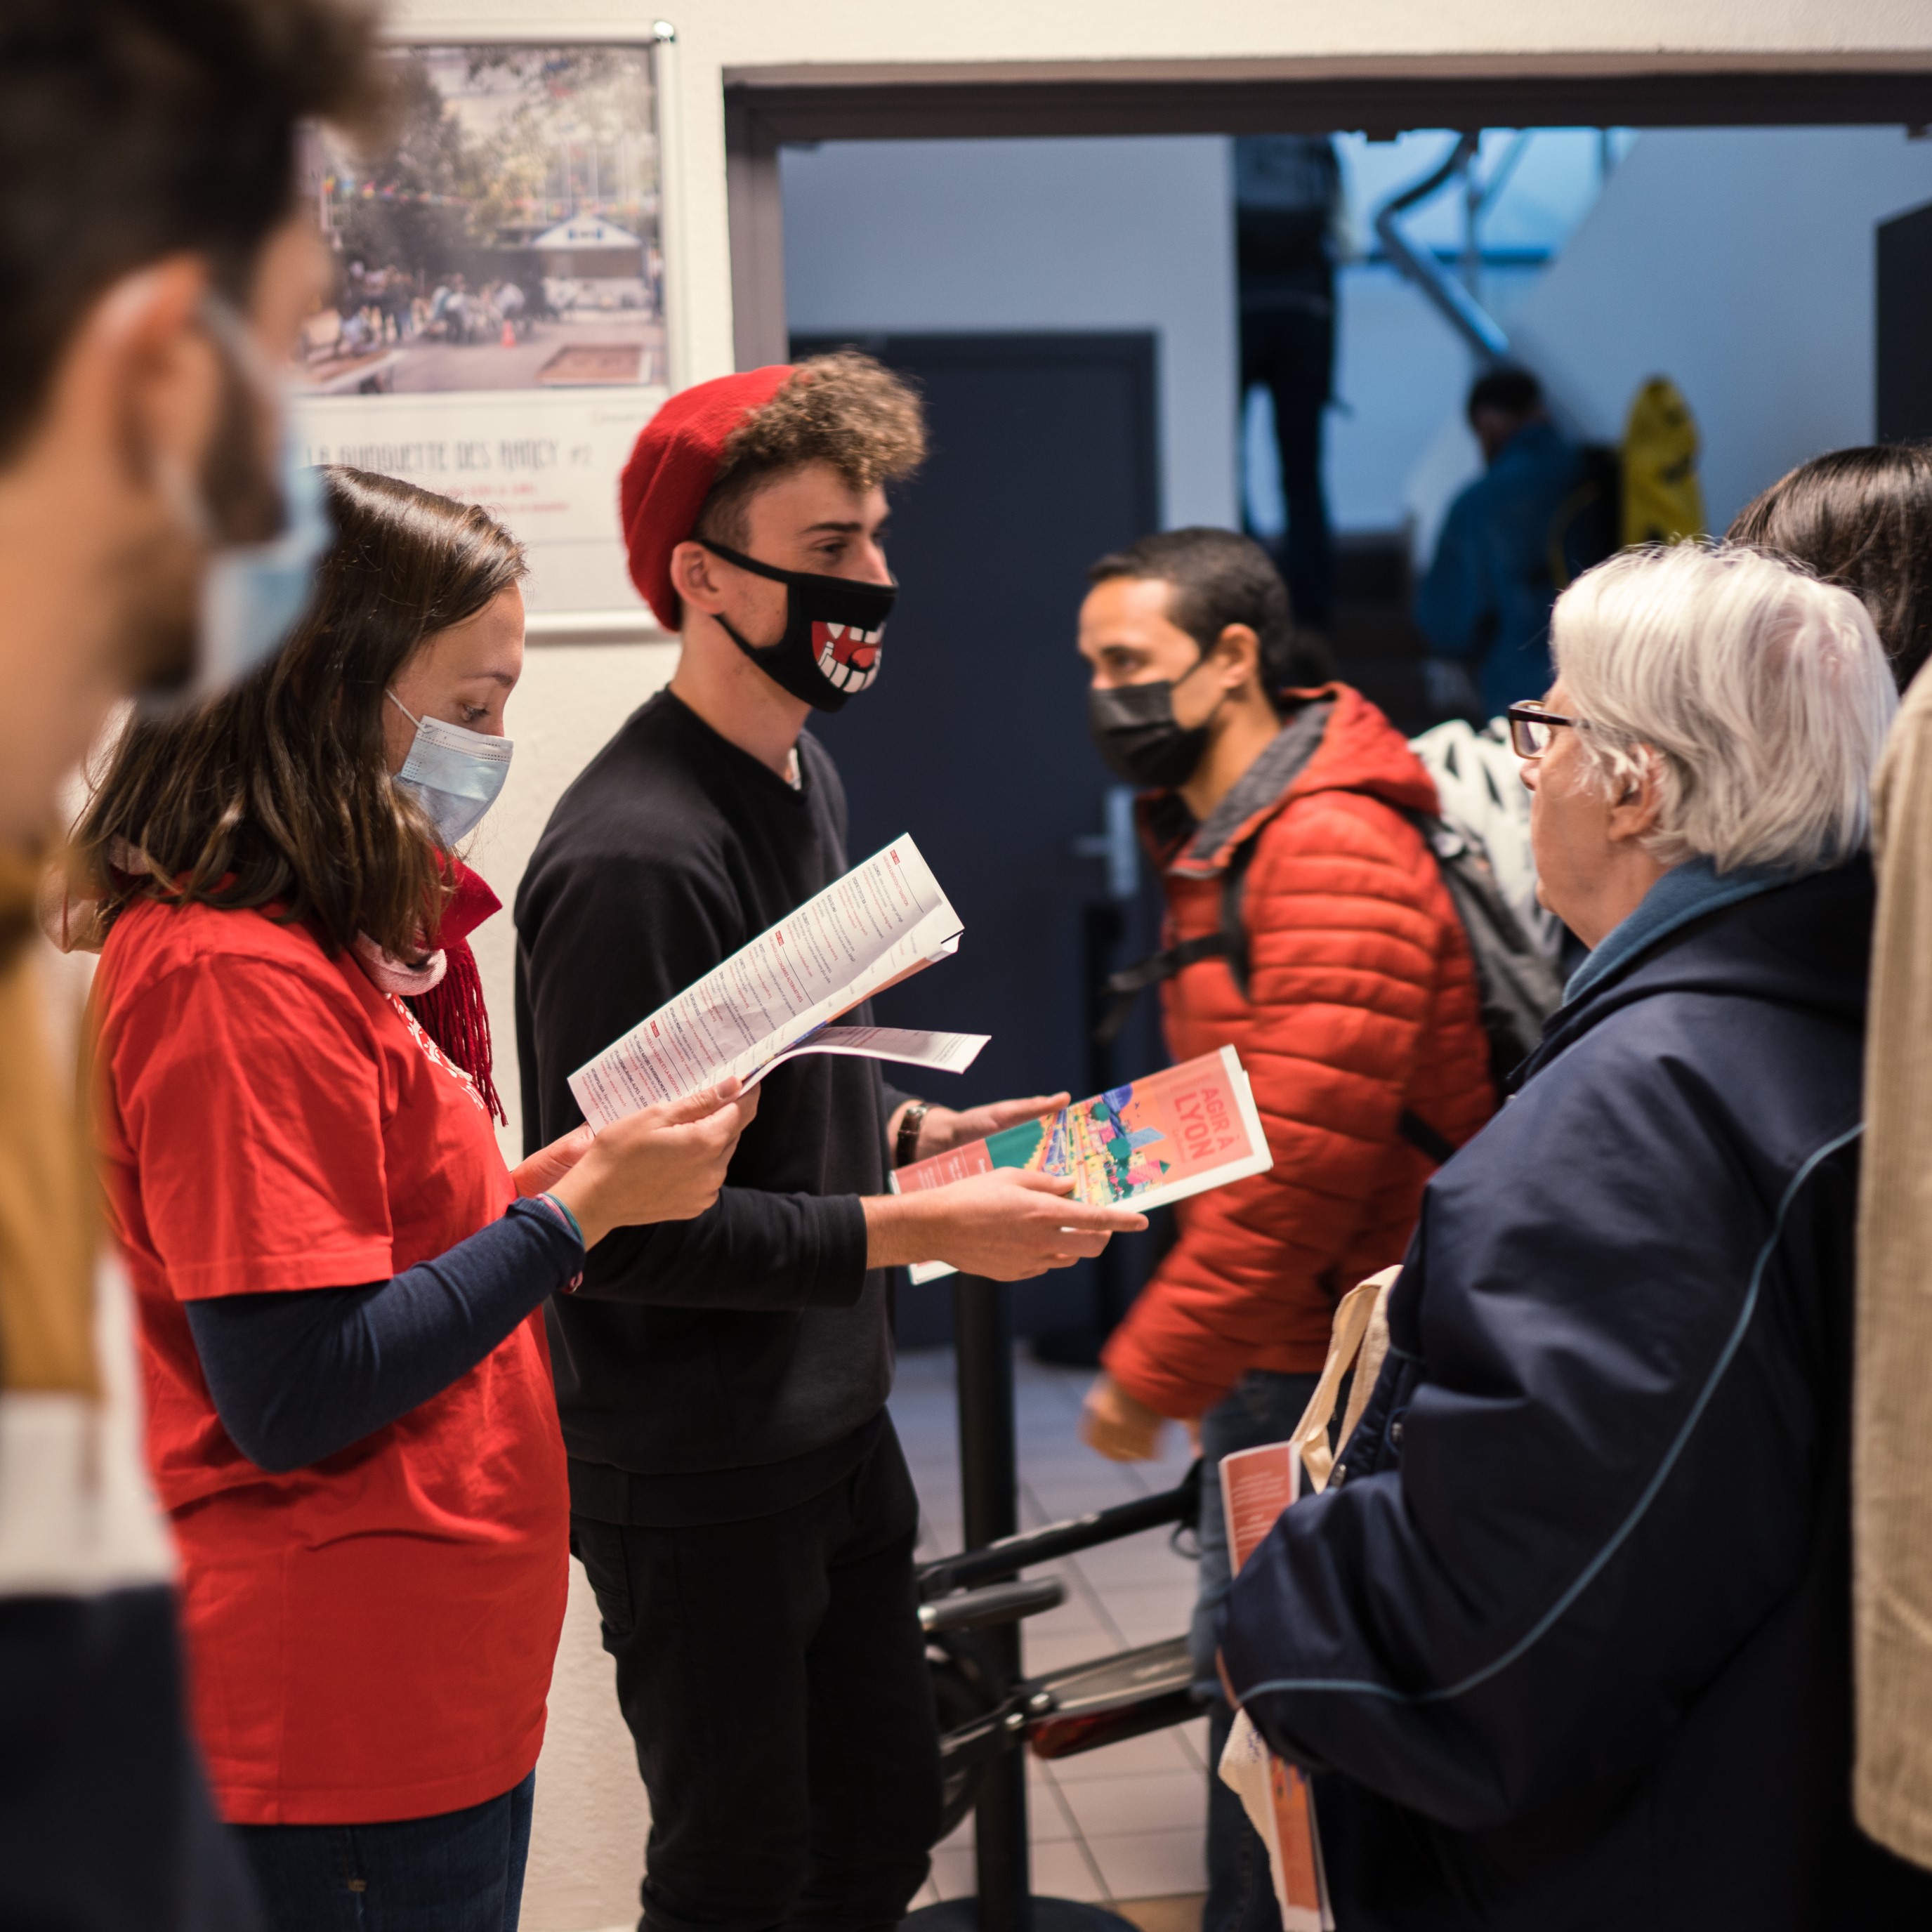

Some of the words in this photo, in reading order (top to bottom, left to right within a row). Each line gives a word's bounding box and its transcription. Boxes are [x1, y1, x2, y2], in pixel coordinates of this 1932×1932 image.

[786, 975, 803, 1003] ALTERNATIVES
[652, 1048, 664, 1065] NATURE
[712, 1040, 724, 1058] consommer
[635, 1040, 643, 1053] FRANCE
[640, 1051, 650, 1066] NATURE
[648, 1065, 666, 1093] ENVIRONNEMENT
[640, 1064, 652, 1081] protection
[1173, 1091, 1215, 1159] LYON
[1200, 1087, 1231, 1133] AGIR
[1216, 1134, 1239, 1150] À
[978, 1157, 987, 1174] Dima
